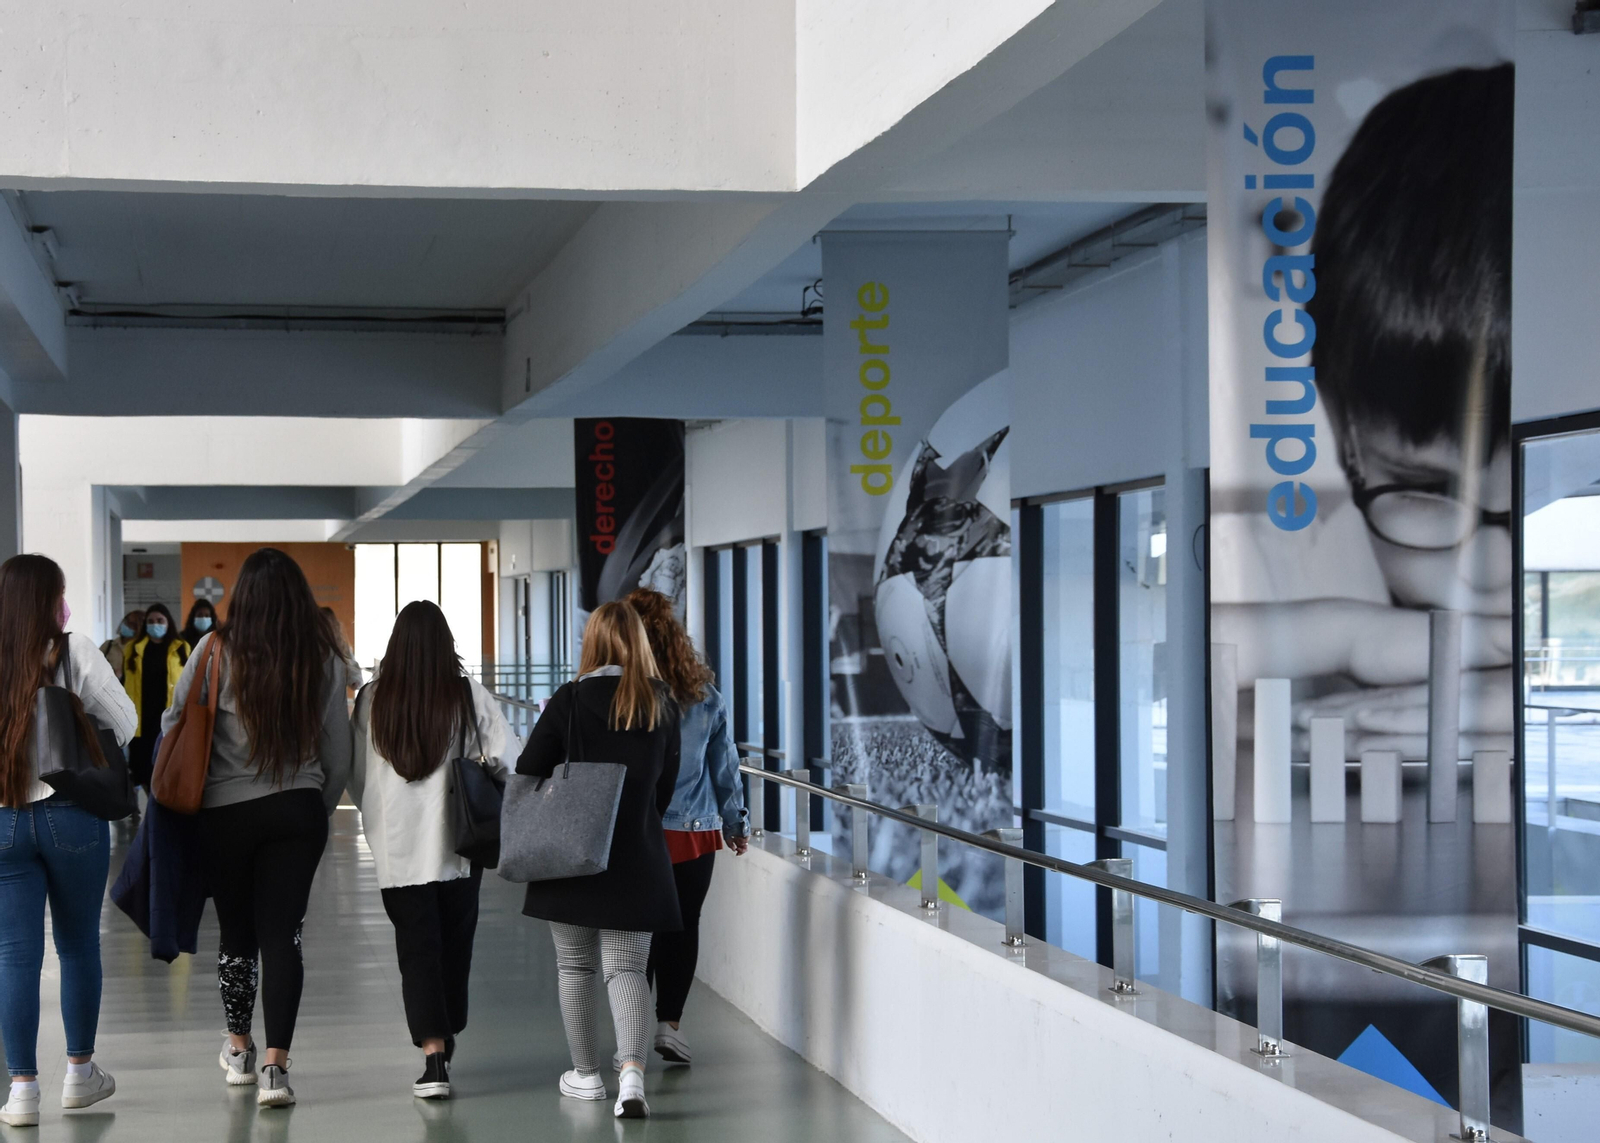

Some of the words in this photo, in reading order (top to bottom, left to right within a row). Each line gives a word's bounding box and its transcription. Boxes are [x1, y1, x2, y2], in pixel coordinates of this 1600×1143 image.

[850, 281, 901, 496] deporte
[1243, 55, 1317, 531] educación
[589, 421, 615, 554] derecho
